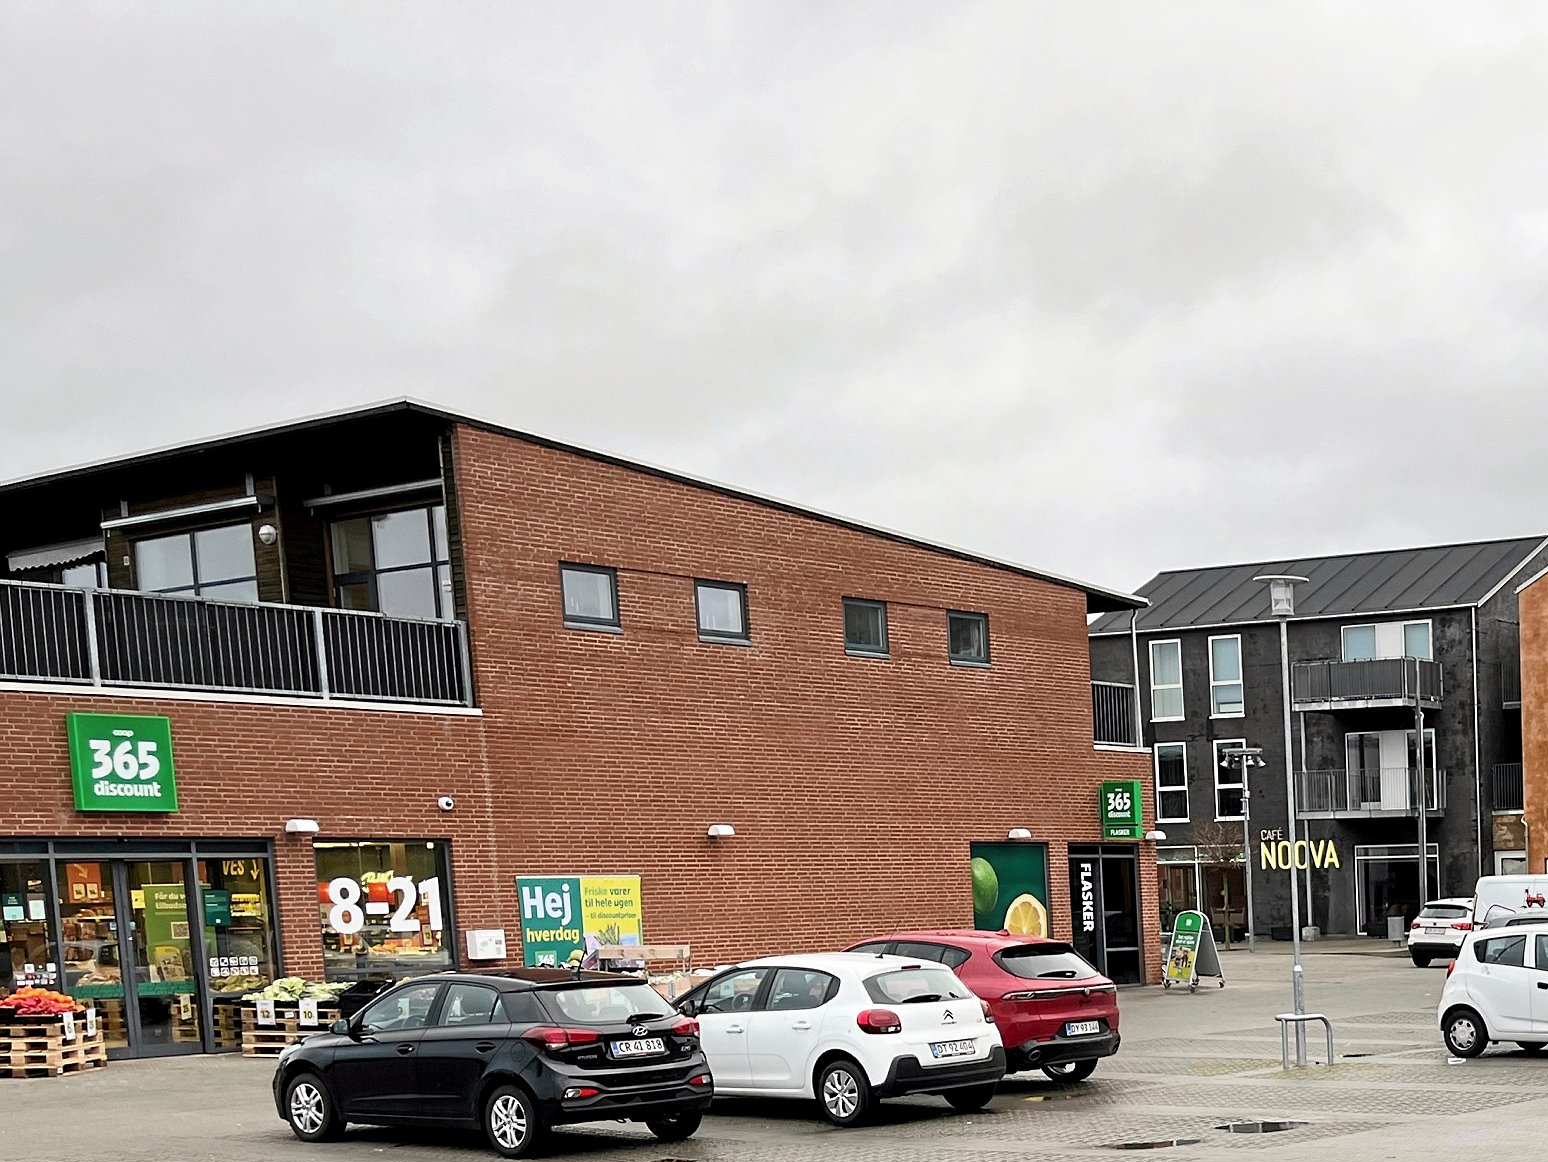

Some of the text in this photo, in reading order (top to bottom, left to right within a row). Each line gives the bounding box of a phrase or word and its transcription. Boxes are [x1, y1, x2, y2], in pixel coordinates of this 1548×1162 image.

[88, 739, 160, 780] 365
[93, 780, 162, 797] discount
[1107, 793, 1131, 810] 365
[1260, 827, 1283, 840] CAFÉ
[1260, 840, 1340, 870] NOOVA
[584, 887, 608, 895] Friske
[1080, 862, 1095, 932] FLASKER
[329, 877, 442, 934] 8-21
[521, 883, 572, 926] Hej
[585, 899, 634, 909] til hele ugen
[526, 926, 580, 944] hverdag
[1080, 1023, 1088, 1032] 93
[619, 1039, 663, 1052] CR 41 818
[937, 1043, 948, 1053] DT
[949, 1042, 958, 1052] 92
